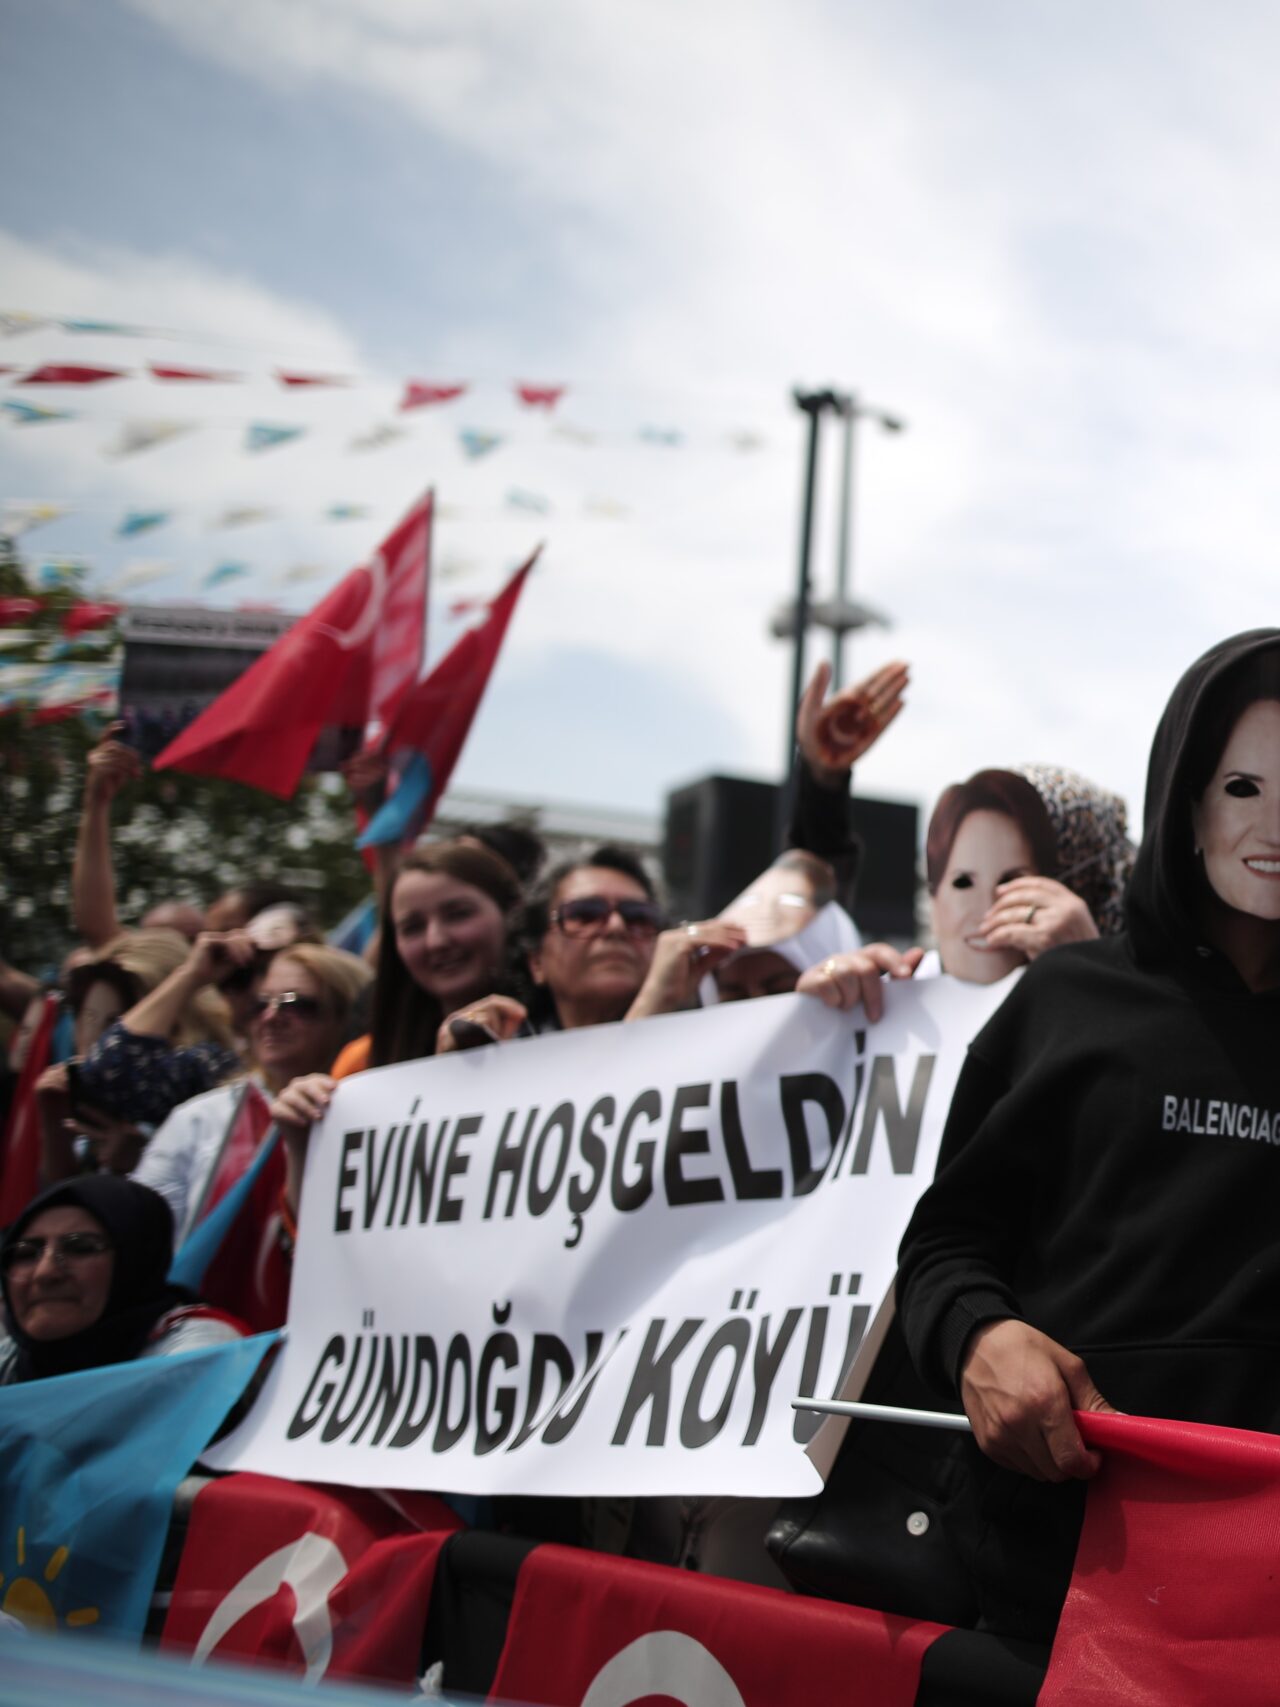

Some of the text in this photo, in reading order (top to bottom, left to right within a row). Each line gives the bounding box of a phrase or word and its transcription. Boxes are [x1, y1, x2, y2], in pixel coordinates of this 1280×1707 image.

[333, 1029, 937, 1249] EVİNE HOŞGELDİN
[286, 1272, 872, 1457] GÜNDOĞDU KÖYÜ
